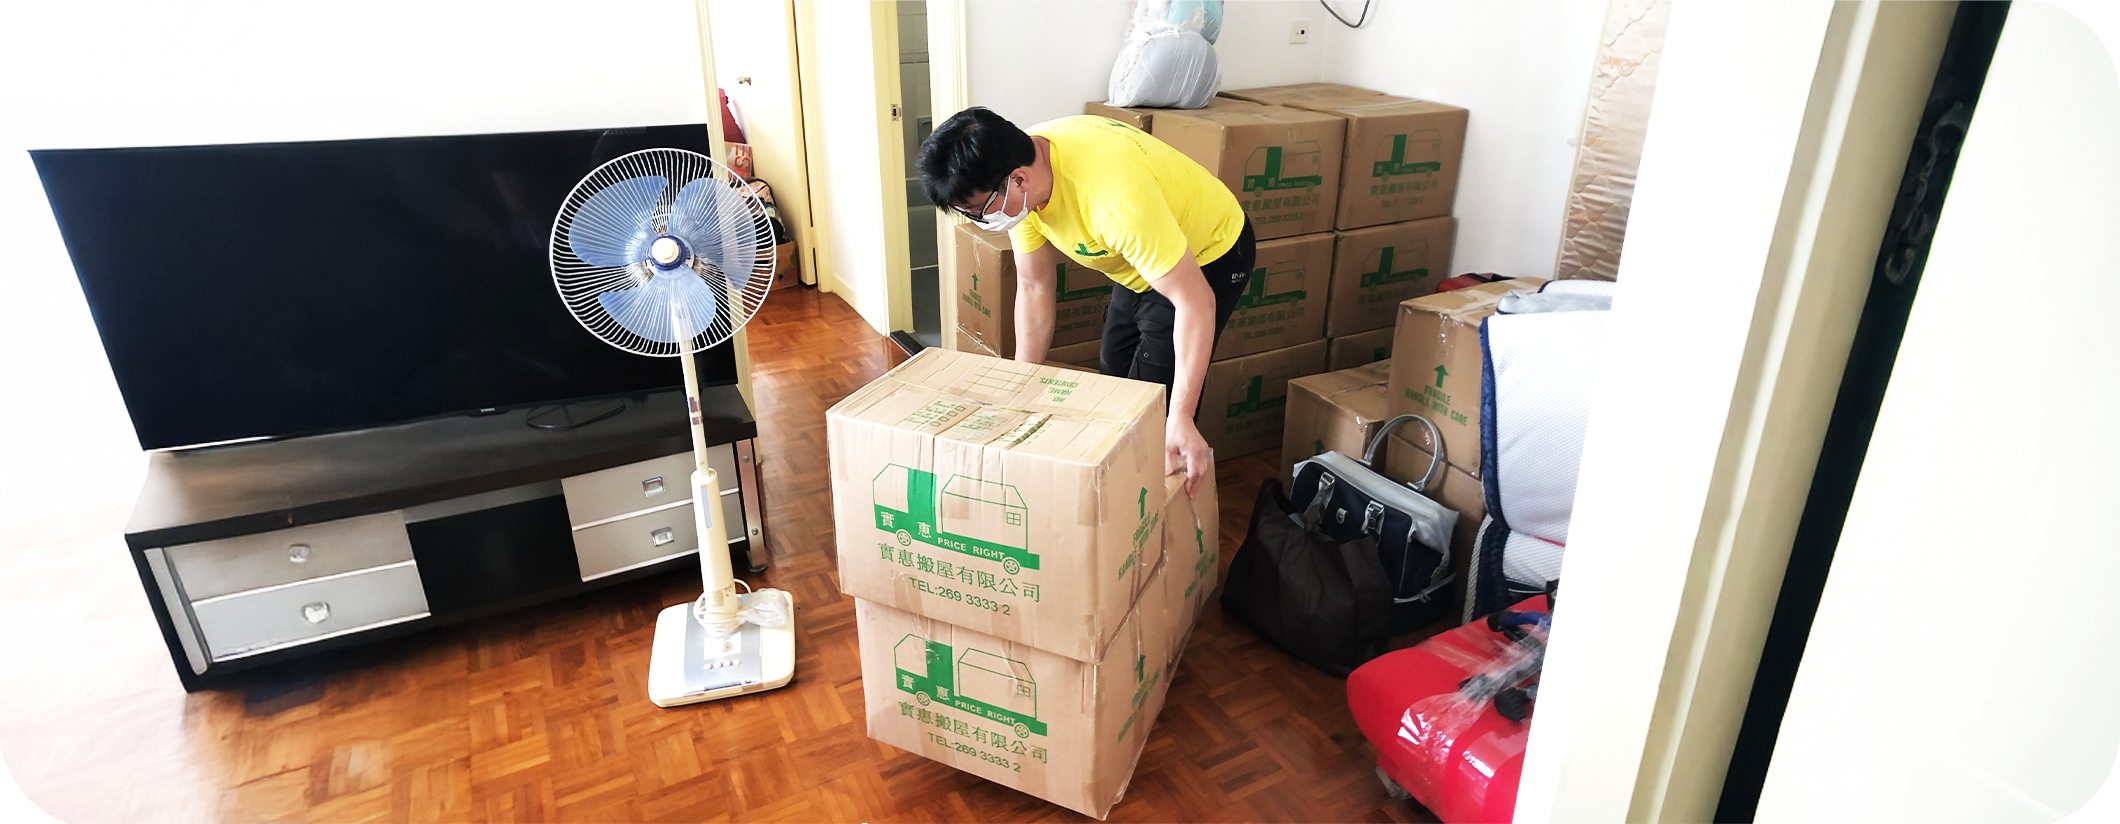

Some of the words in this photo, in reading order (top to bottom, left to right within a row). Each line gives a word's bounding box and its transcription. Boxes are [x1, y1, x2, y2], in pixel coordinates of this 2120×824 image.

[1405, 387, 1430, 407] HANDLE
[1432, 400, 1449, 417] WITH
[1450, 409, 1468, 427] CARE
[1424, 384, 1451, 406] FRAGILE
[880, 511, 895, 529] 實
[917, 521, 932, 539] 惠
[937, 537, 967, 552] PRICE
[972, 545, 1005, 561] RIGHT
[878, 543, 1040, 603] 實惠搬屋有限公司
[908, 576, 962, 602] TEL:269
[965, 594, 999, 612] 3333
[1002, 604, 1011, 616] 2
[901, 674, 915, 690] 實
[935, 685, 950, 701] 惠
[954, 700, 982, 714] PRICE
[986, 709, 1016, 725] RIGHT
[898, 701, 1048, 764] 實惠搬屋有限公司
[927, 732, 977, 757] TEL:269
[980, 751, 1010, 769] 3333
[1013, 762, 1021, 772] 2
